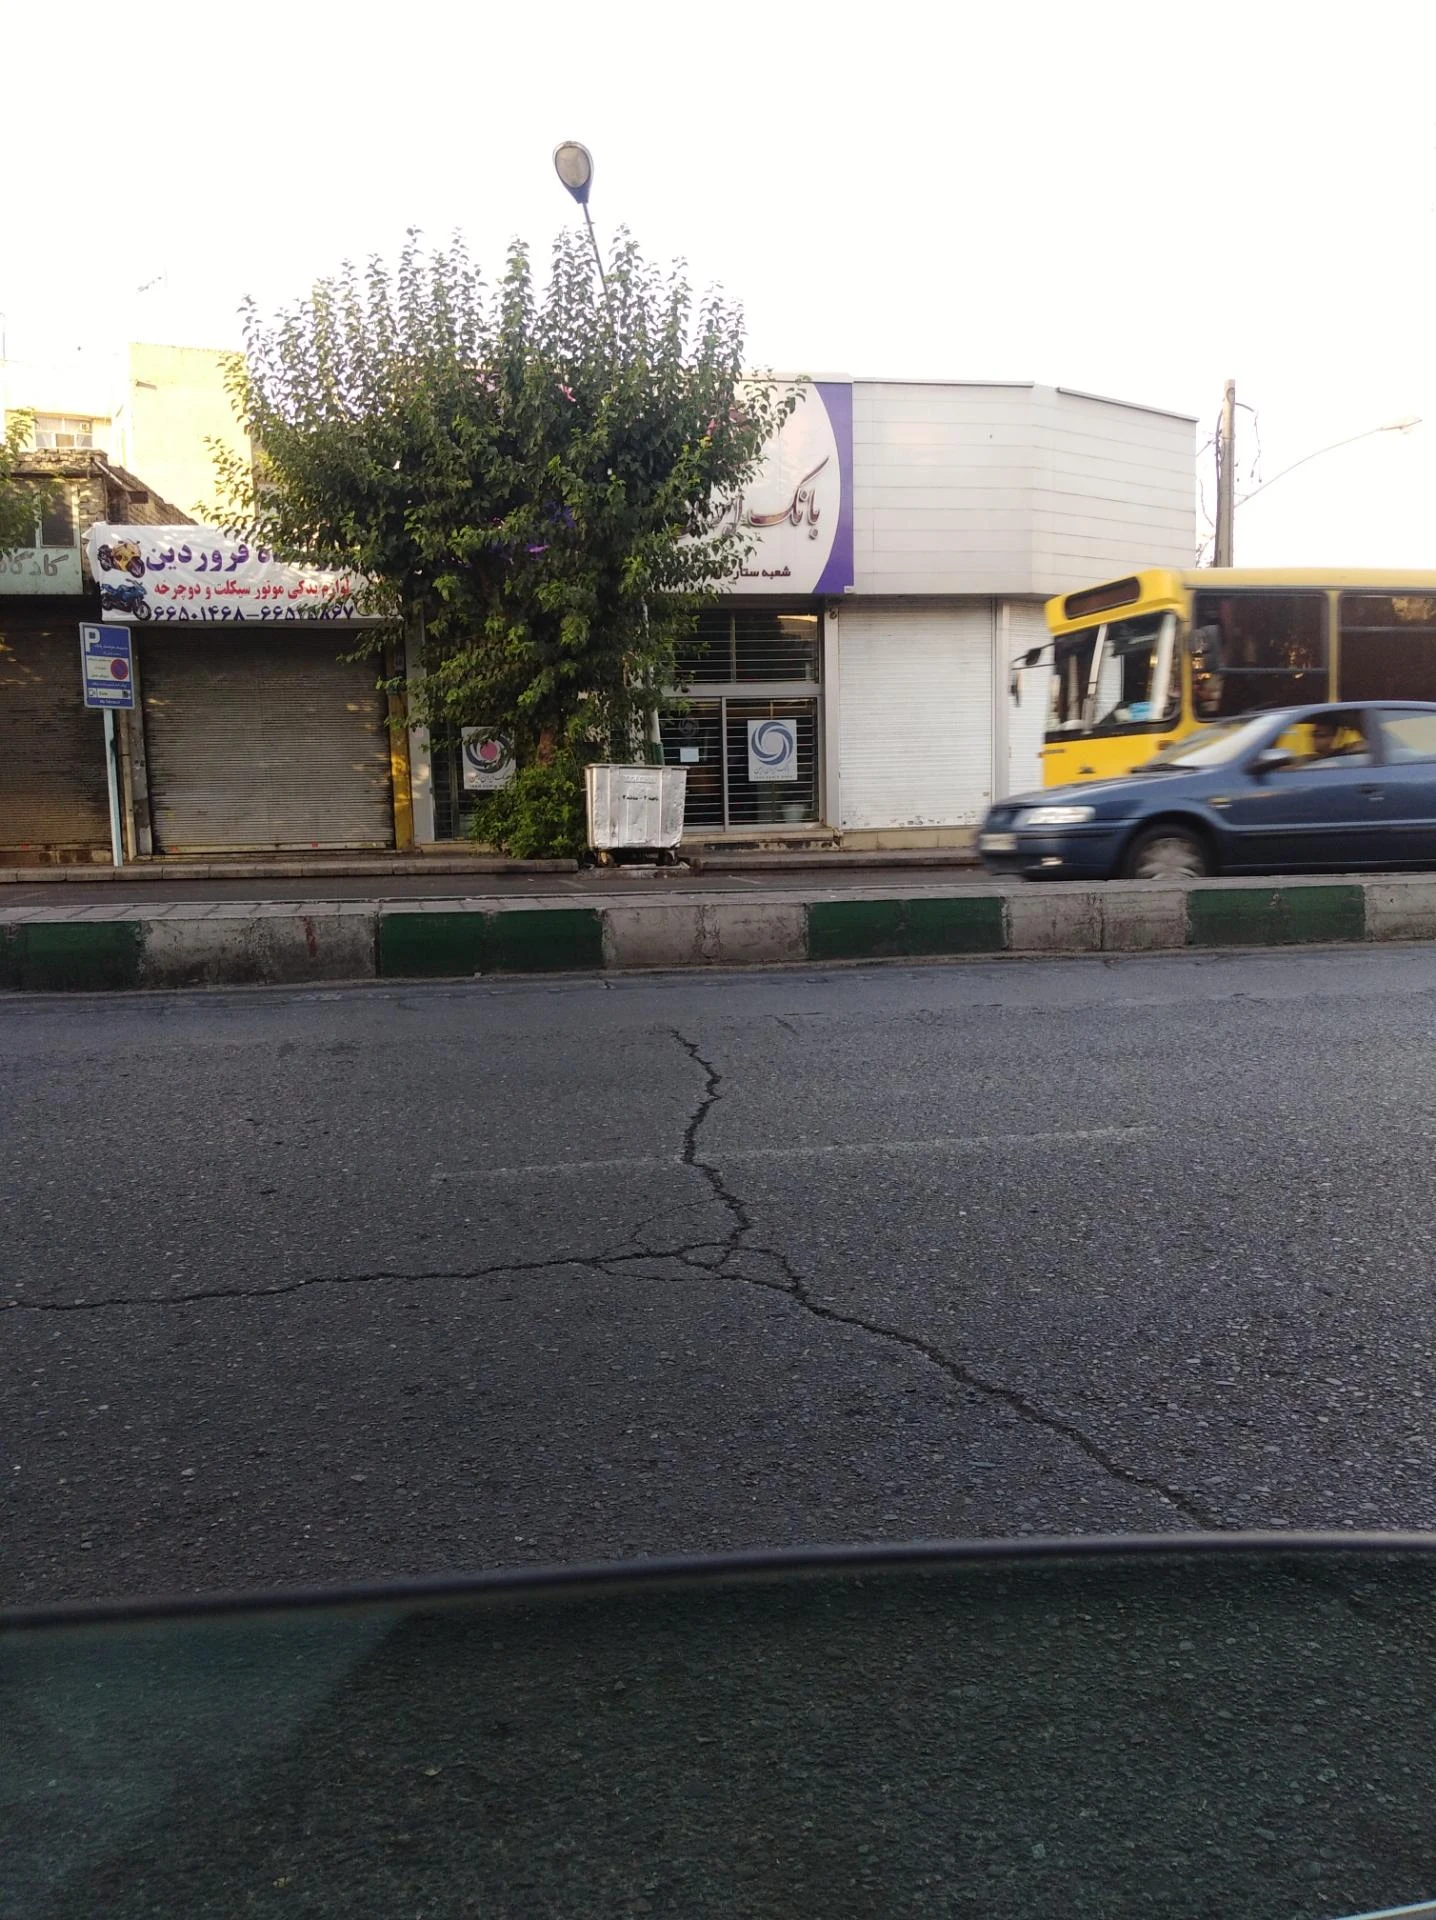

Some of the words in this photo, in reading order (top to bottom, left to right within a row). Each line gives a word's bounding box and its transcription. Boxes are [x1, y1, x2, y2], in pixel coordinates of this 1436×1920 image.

[748, 456, 830, 540] بانک
[146, 544, 250, 572] فروردین
[761, 566, 791, 580] شعبه
[154, 579, 202, 601] دوچرخه
[204, 587, 212, 600] و
[213, 579, 251, 599] سیکلت
[254, 579, 285, 600] موتور
[287, 579, 318, 600] یدکی
[84, 627, 101, 653] P
